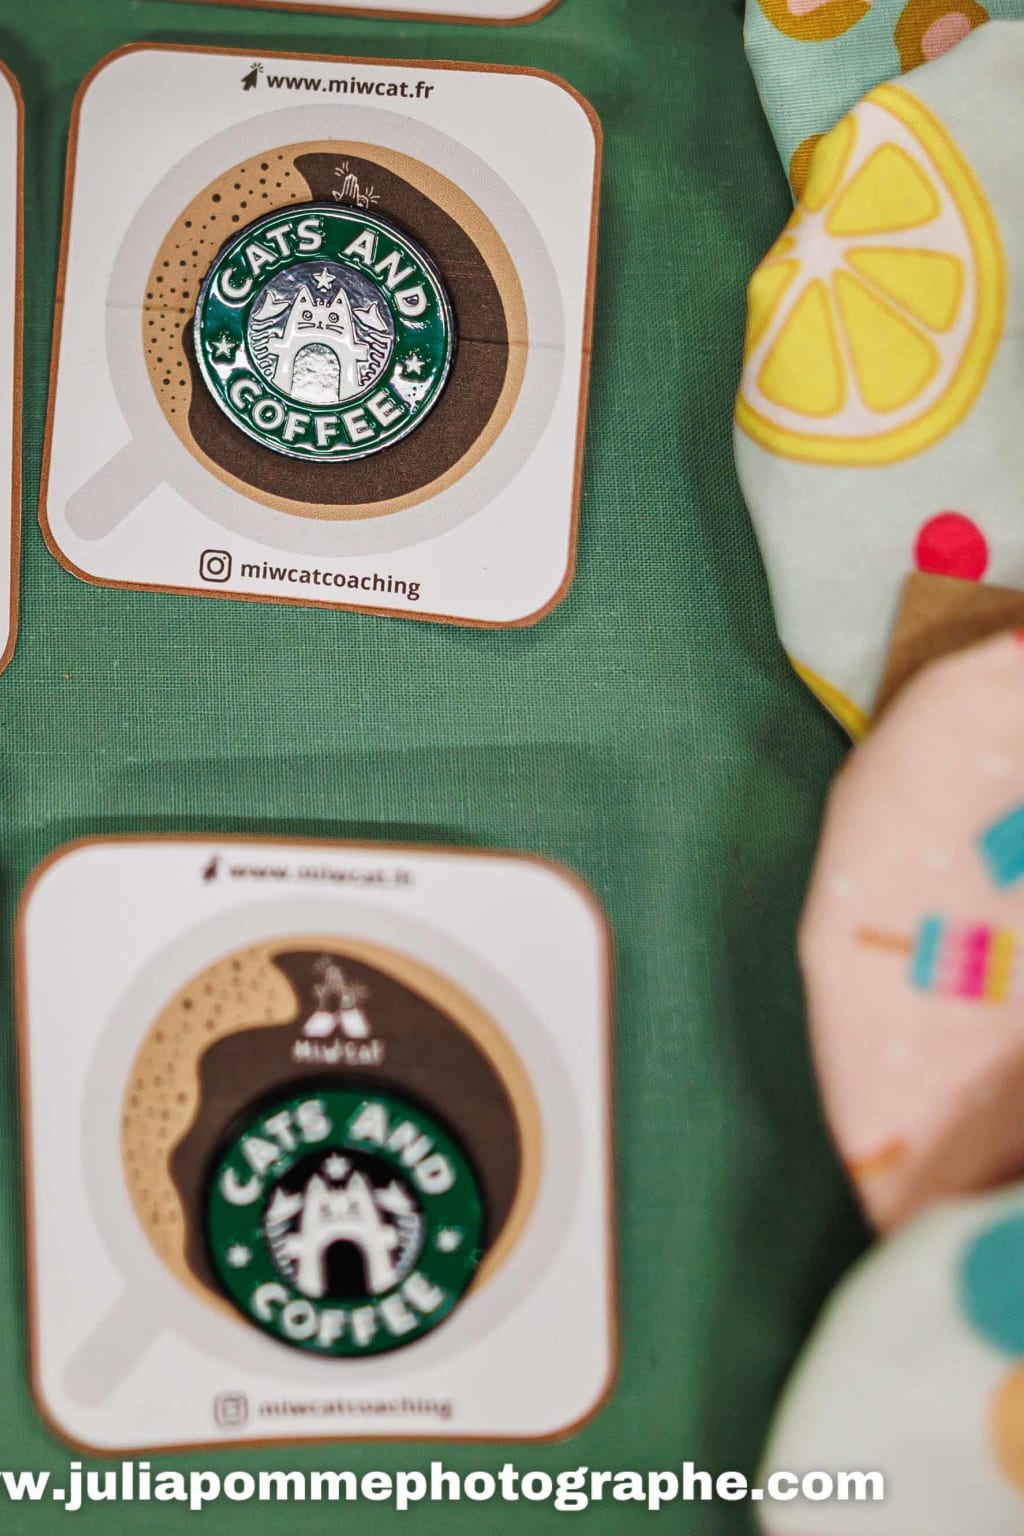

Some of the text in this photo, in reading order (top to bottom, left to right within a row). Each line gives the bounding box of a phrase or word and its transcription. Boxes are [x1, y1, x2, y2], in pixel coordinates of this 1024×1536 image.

[267, 74, 434, 99] www.miwcat.fr
[219, 217, 429, 318] CATS AND
[230, 388, 406, 447] COFFEE
[240, 559, 421, 601] miwcatcoaching
[220, 1099, 456, 1205] CATS AND
[251, 1271, 446, 1346] COFFEE
[259, 1394, 454, 1420] miwcatcoaching
